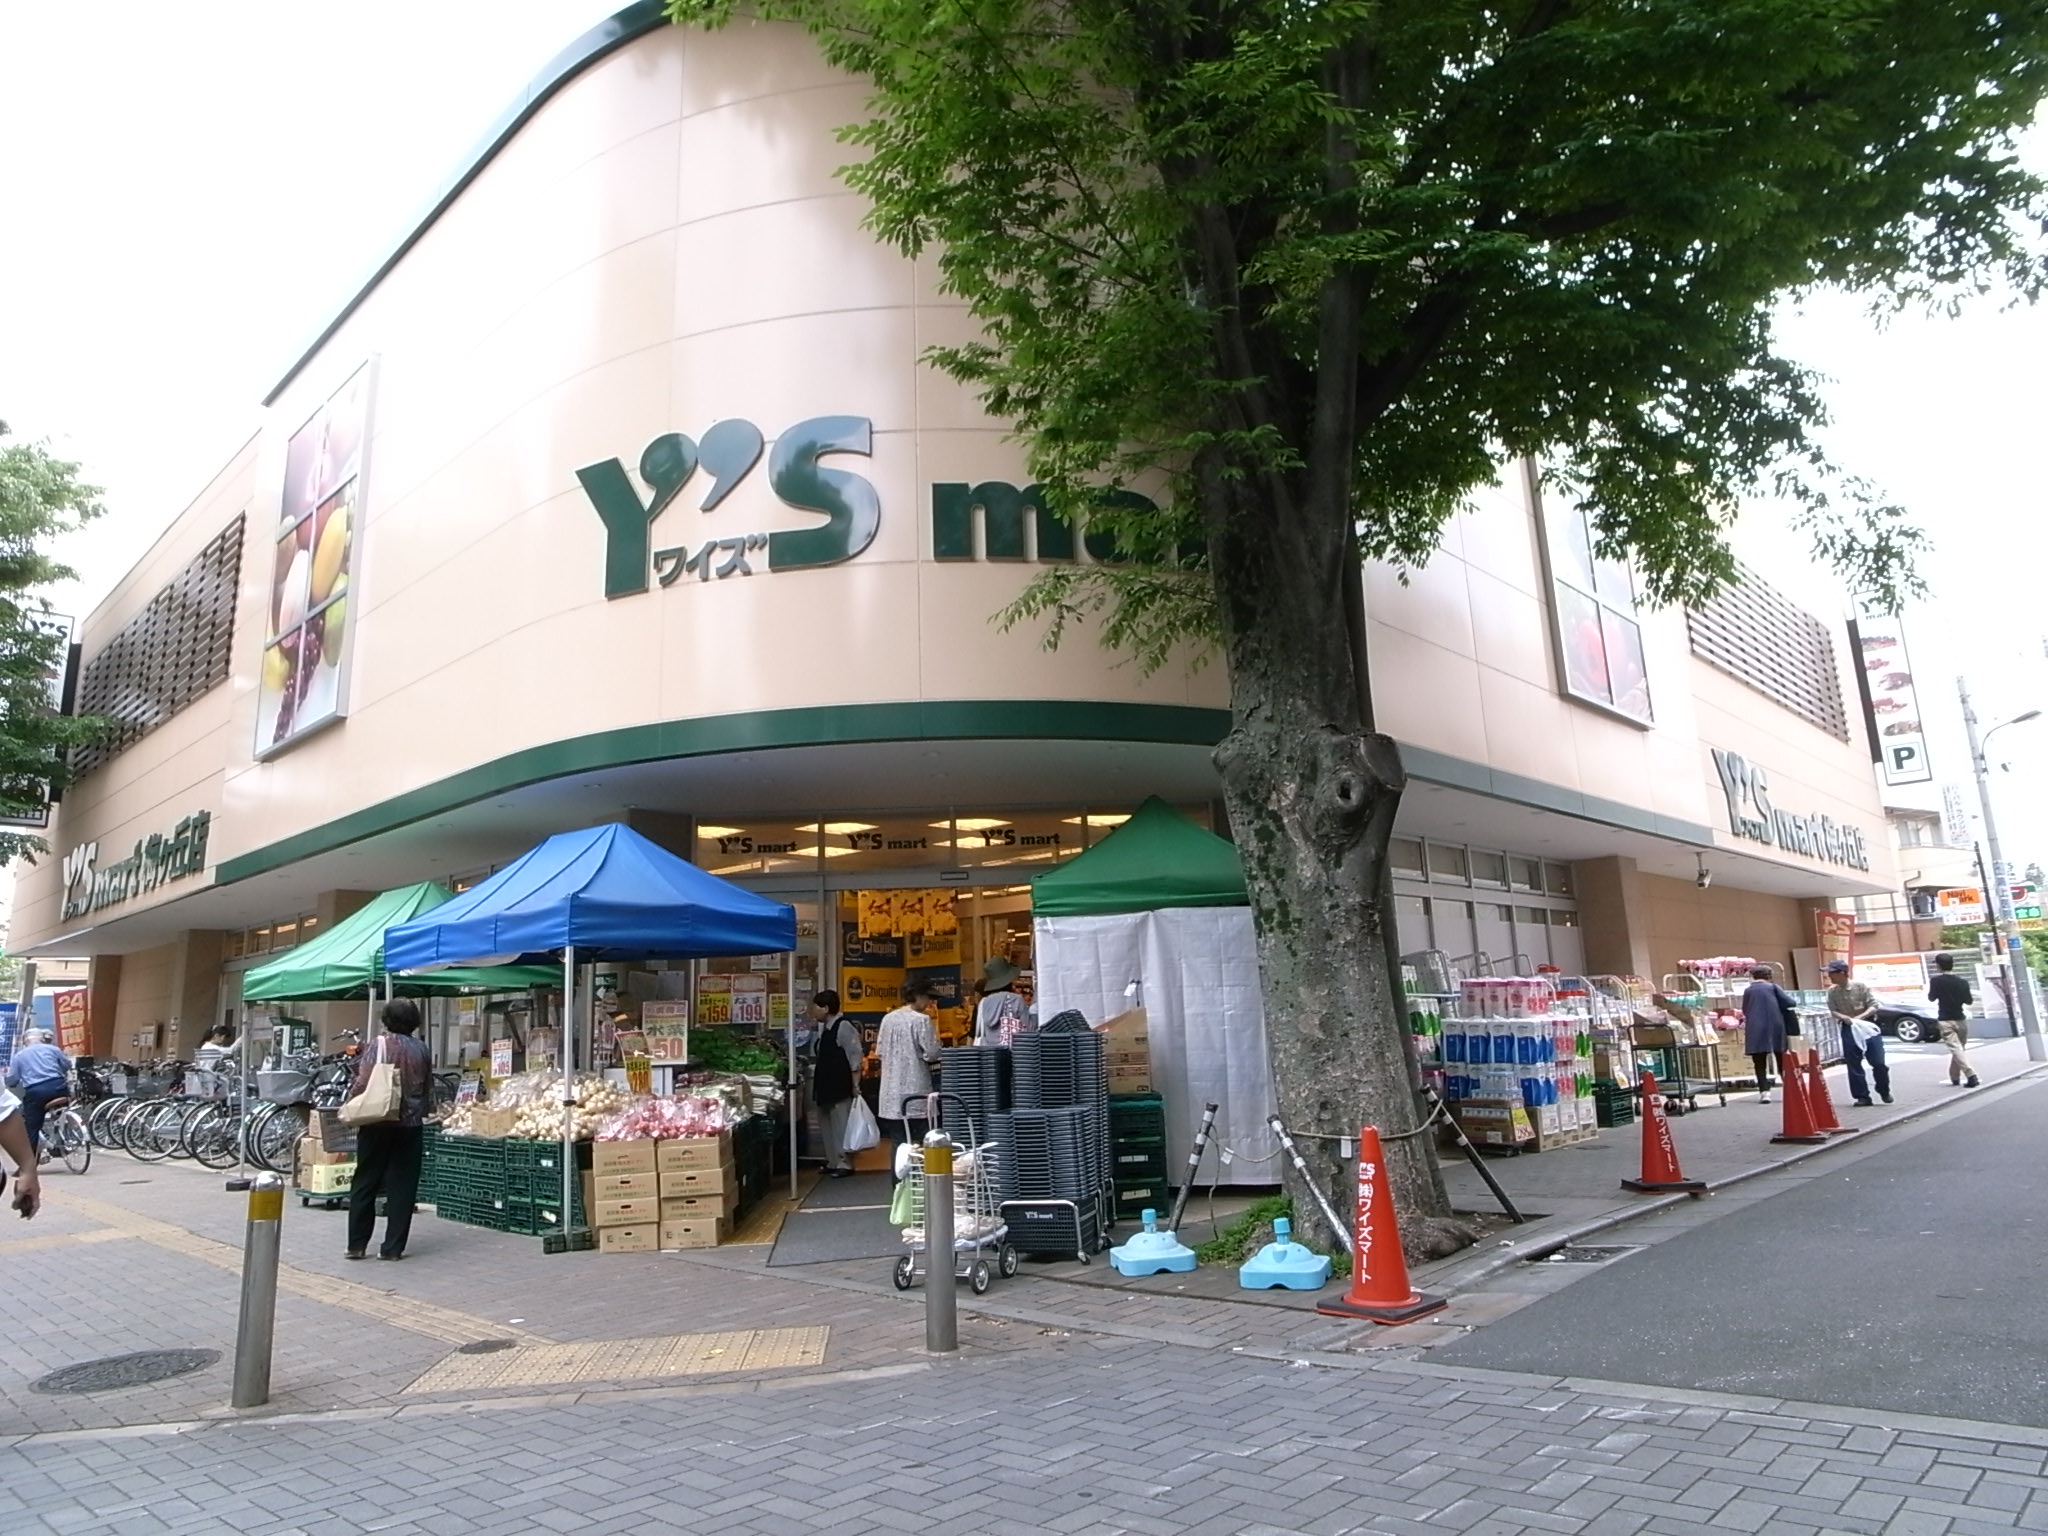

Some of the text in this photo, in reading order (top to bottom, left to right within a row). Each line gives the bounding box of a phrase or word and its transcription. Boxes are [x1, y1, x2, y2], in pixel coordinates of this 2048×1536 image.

[653, 532, 767, 587] ワイズ
[1893, 747, 1915, 770] P
[758, 841, 797, 853] mart
[887, 837, 927, 849] mart
[1021, 833, 1060, 845] mart
[863, 940, 897, 956] Chiquita
[865, 984, 898, 1000] Chiquita
[706, 1004, 728, 1022] 159
[739, 1004, 762, 1021] 199
